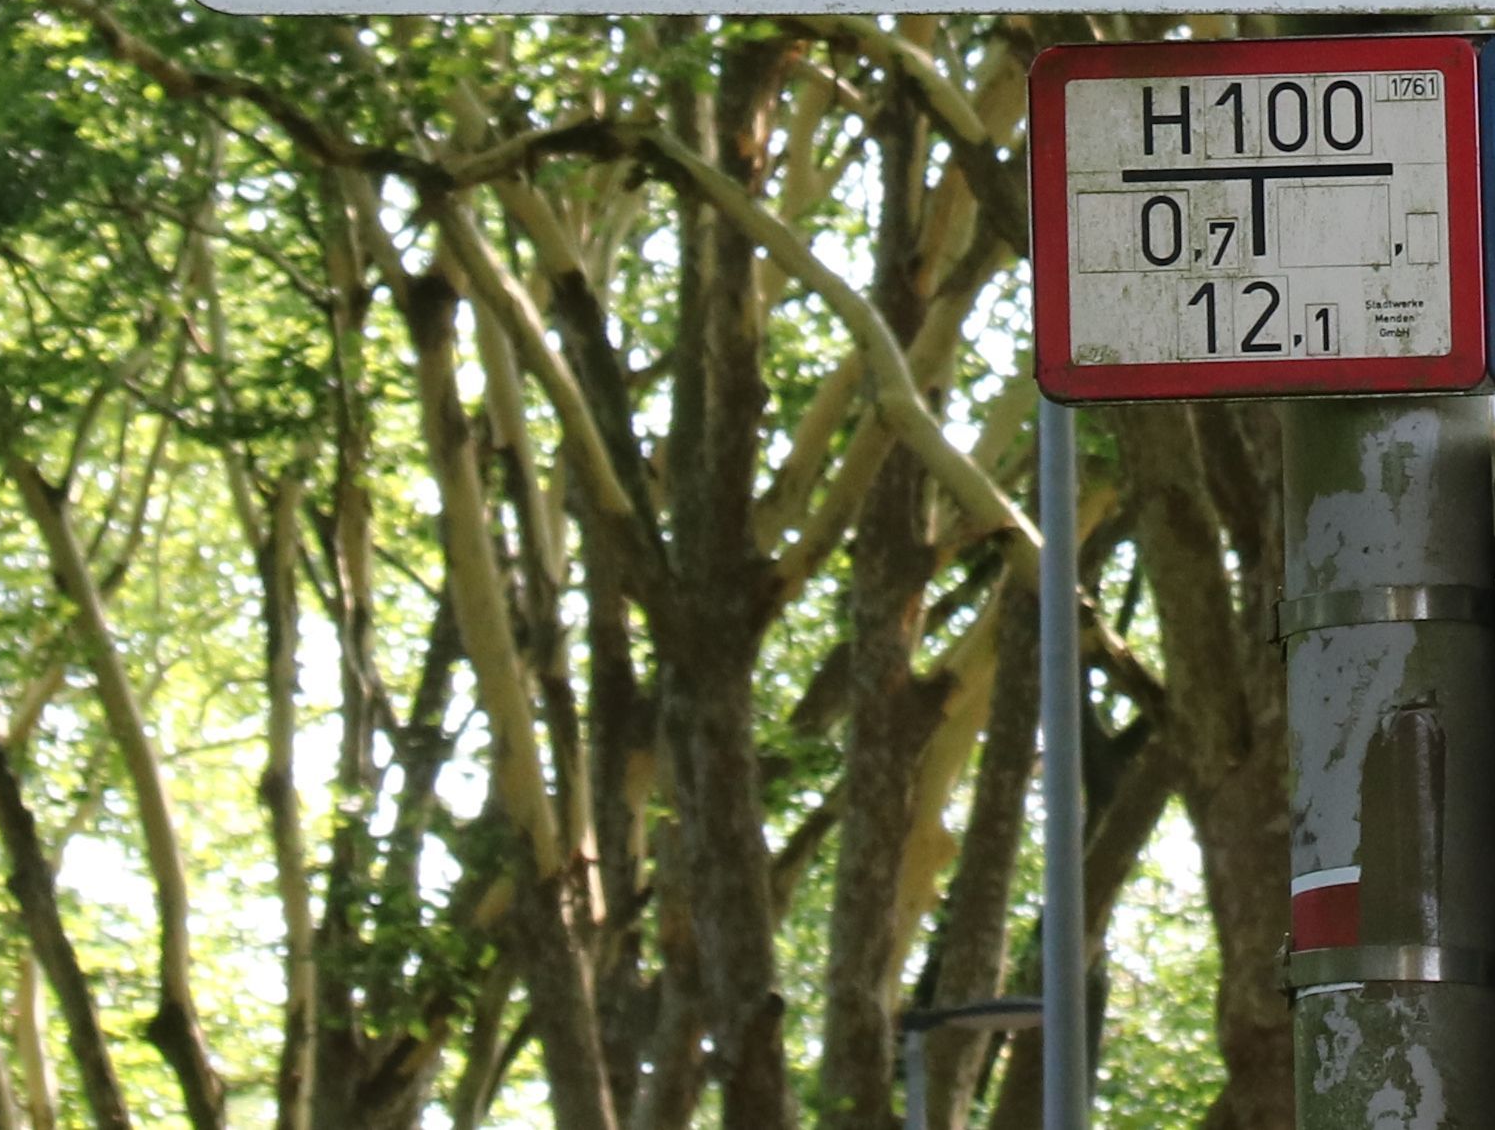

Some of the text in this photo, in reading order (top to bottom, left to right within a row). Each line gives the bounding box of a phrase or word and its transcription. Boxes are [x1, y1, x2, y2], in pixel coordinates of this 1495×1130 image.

[1390, 76, 1437, 97] 1761
[1142, 79, 1364, 156] H100
[1364, 298, 1425, 311] Stadtwerke
[1186, 280, 1331, 354] 12,1
[1375, 314, 1416, 324] Menden
[1379, 327, 1411, 338] GmbH
